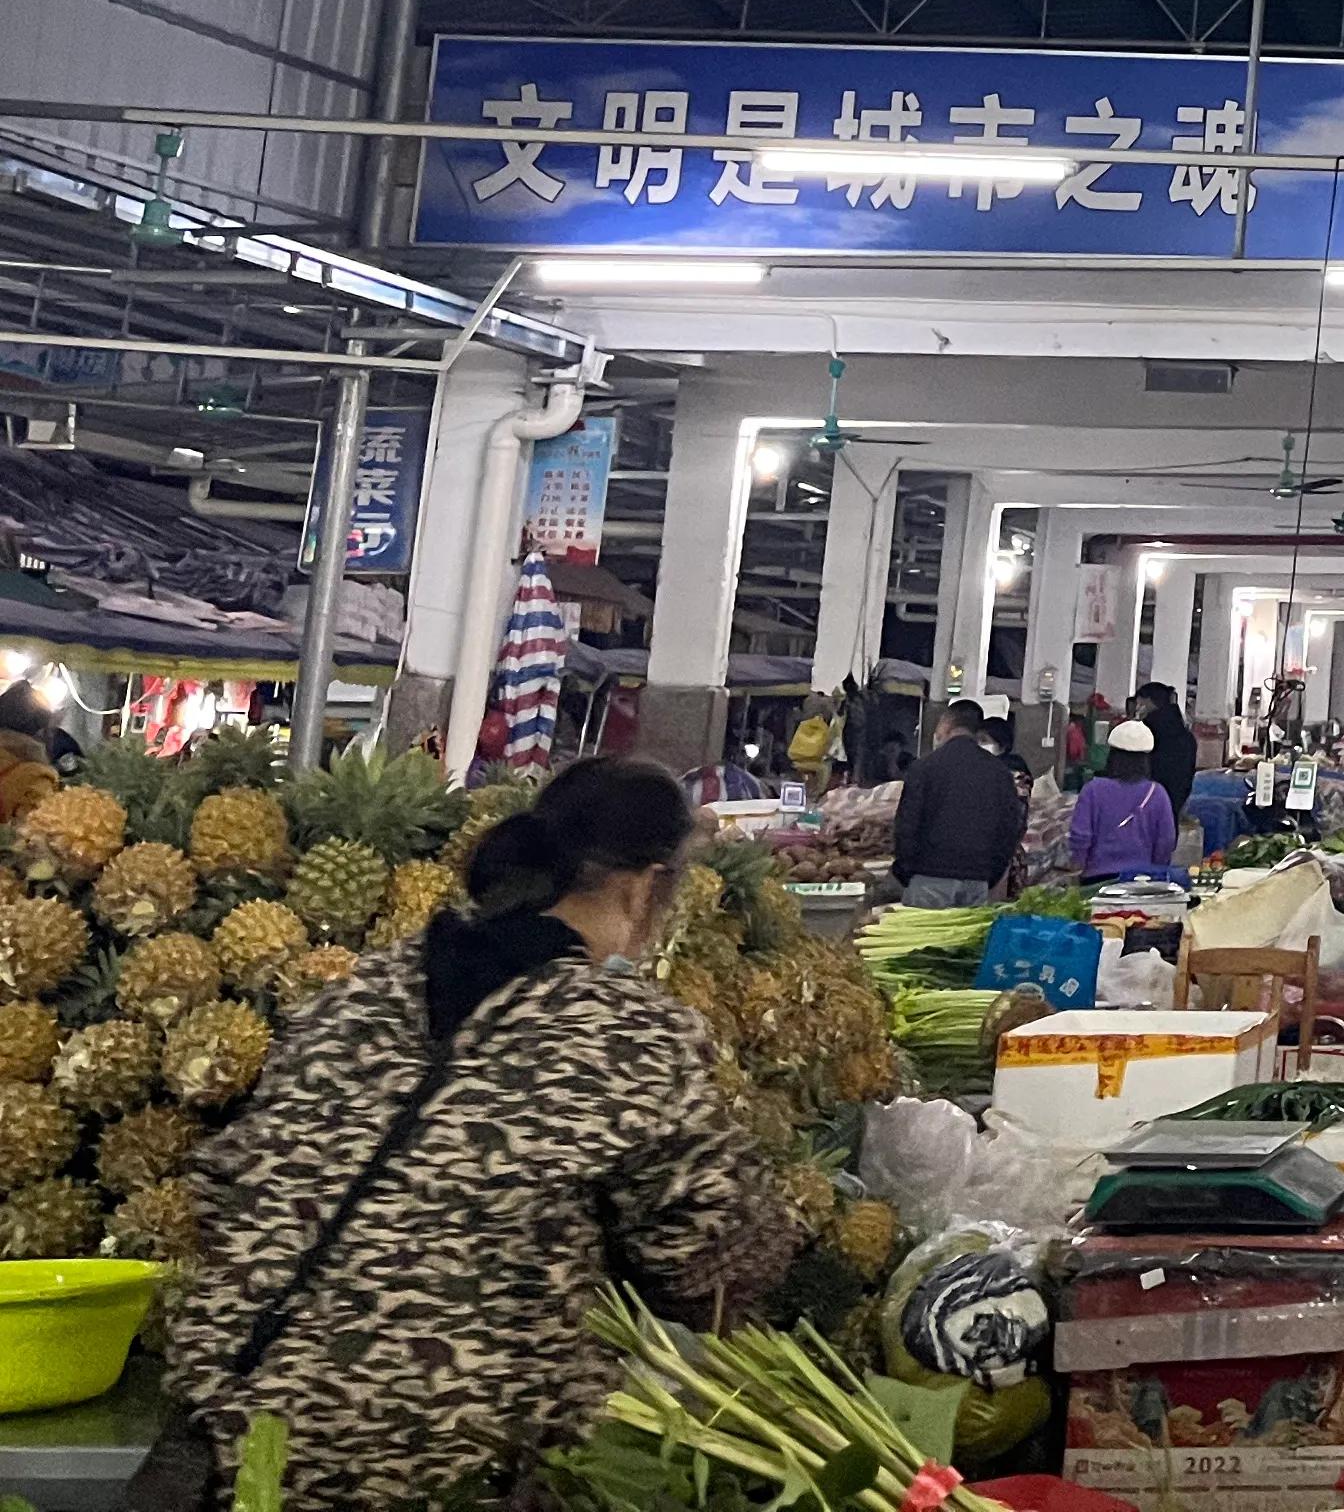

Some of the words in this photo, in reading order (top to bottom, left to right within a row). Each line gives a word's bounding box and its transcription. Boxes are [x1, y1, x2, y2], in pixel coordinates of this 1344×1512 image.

[472, 83, 1259, 214] 文明是城市之魂
[1184, 1456, 1242, 1475] 2022
